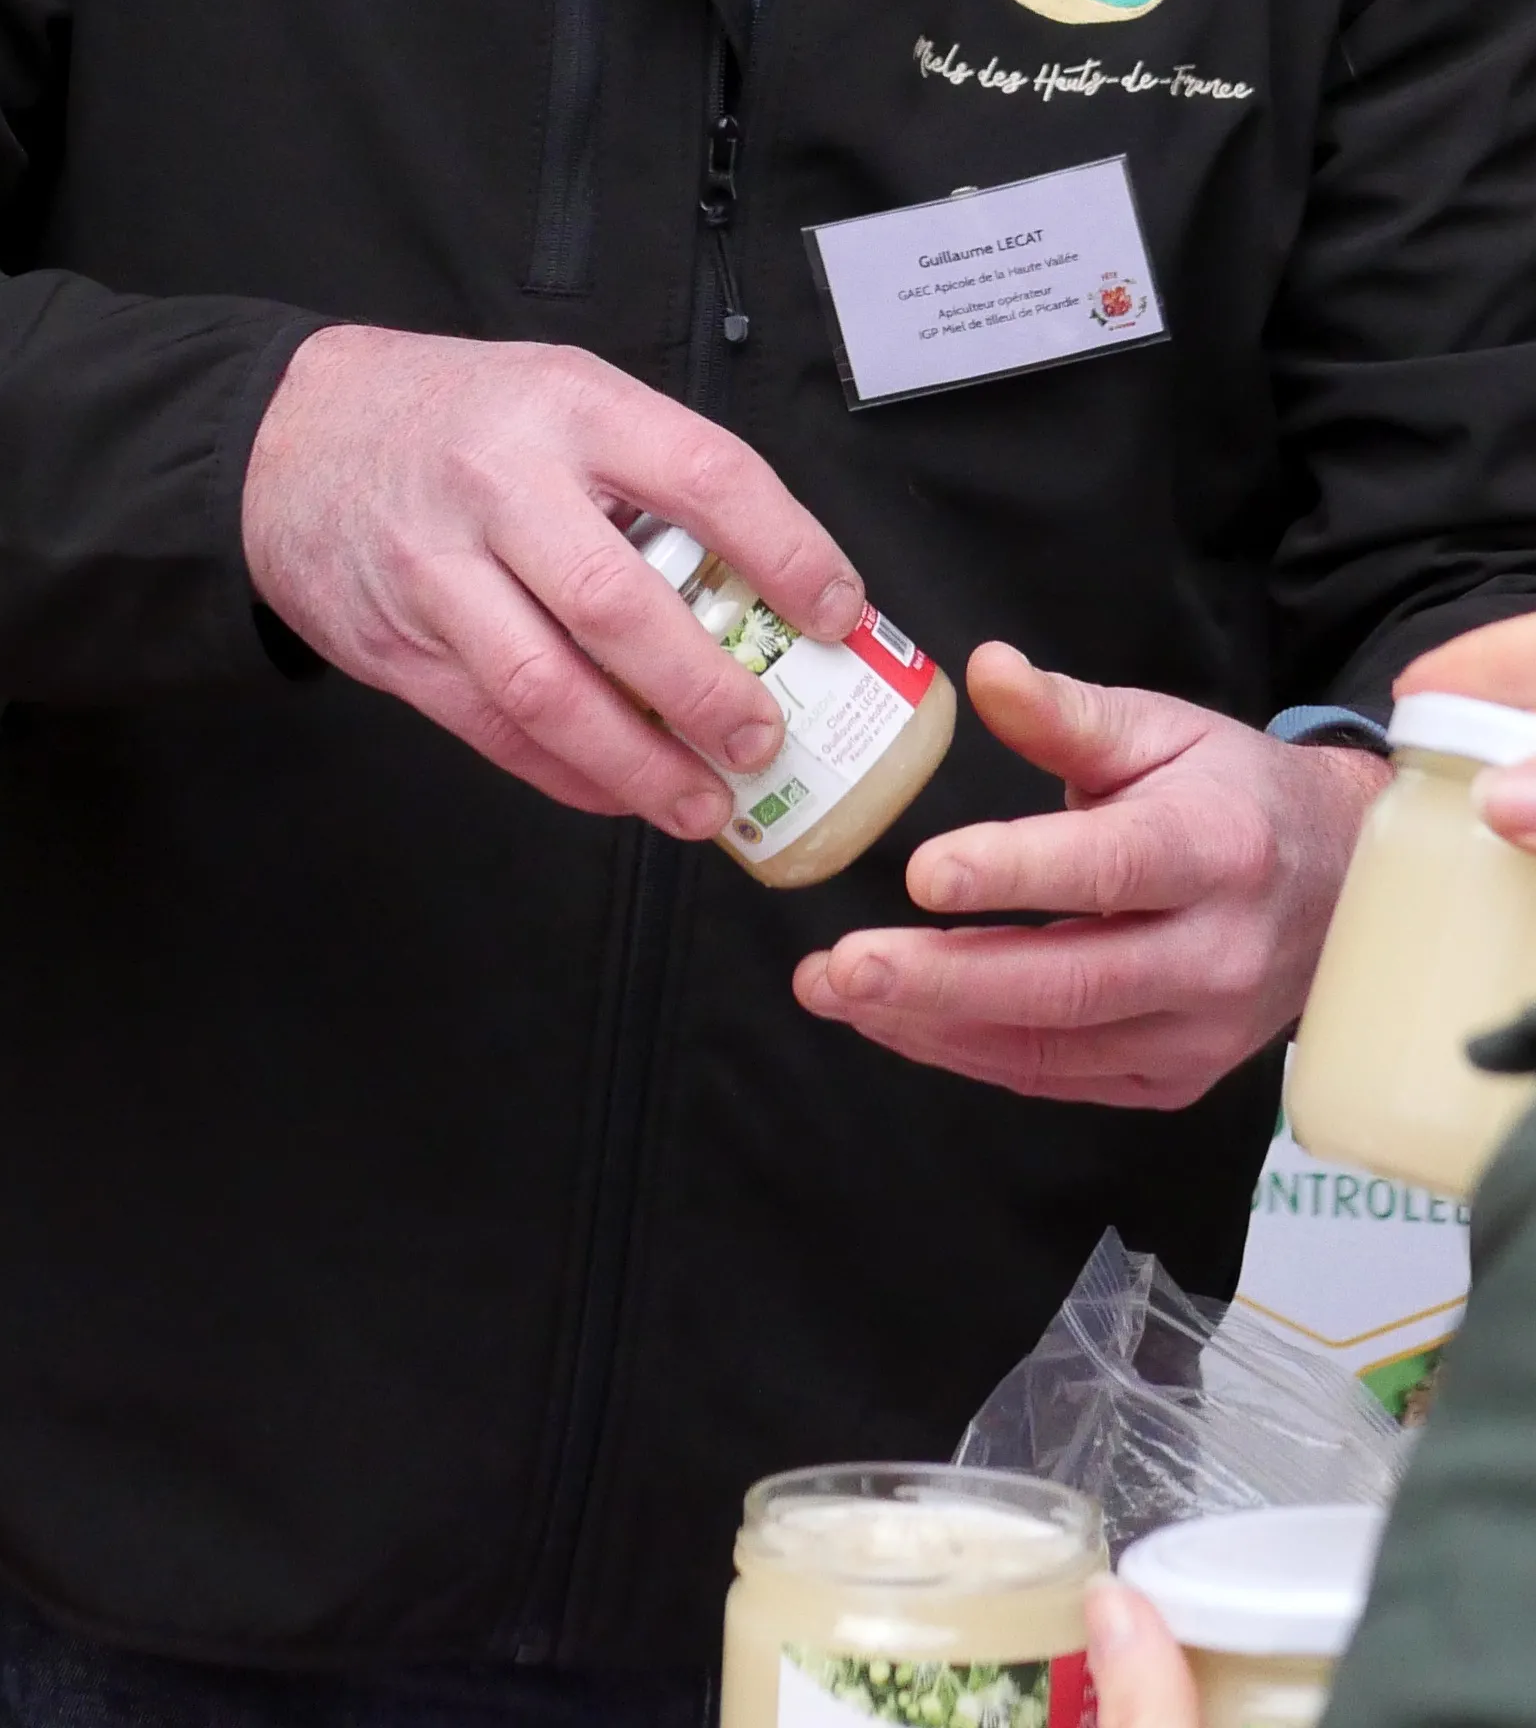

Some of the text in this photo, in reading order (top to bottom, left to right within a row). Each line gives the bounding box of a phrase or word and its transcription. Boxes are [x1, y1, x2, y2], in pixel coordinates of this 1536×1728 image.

[977, 56, 1029, 94] des
[1033, 57, 1256, 103] Hauts-de-France
[918, 229, 1045, 269] Guillaume LECAT
[897, 251, 1080, 302] GAEC Apicole de la Haute Vallée
[919, 296, 1081, 341] IGP Miel de tilleul de Picardie
[938, 286, 1052, 320] Apiculteur opérateur
